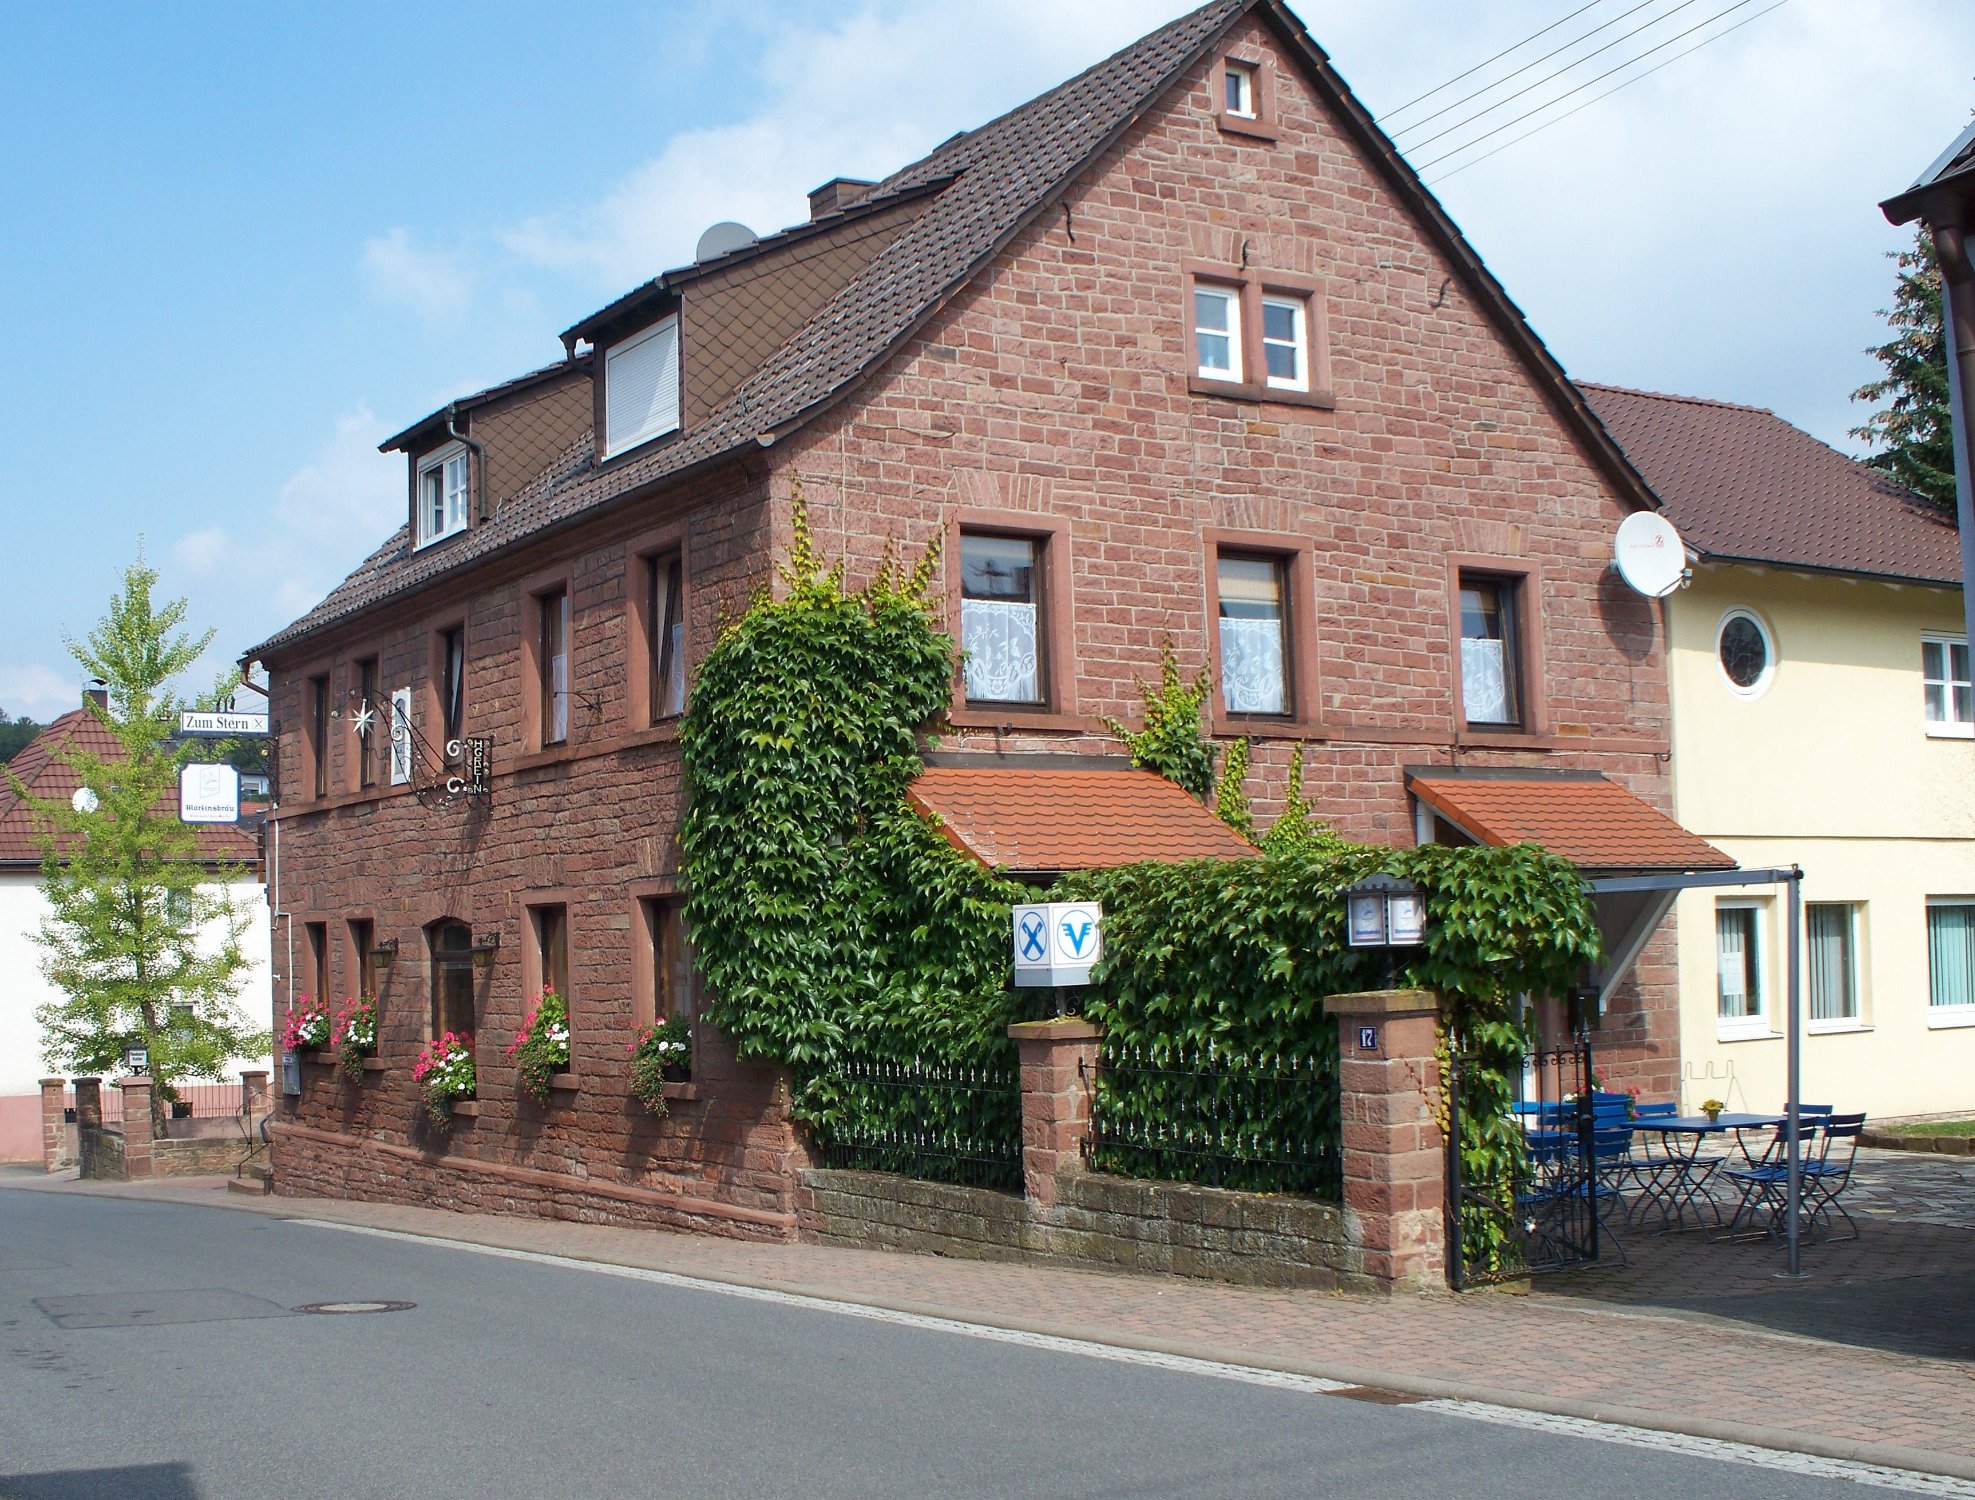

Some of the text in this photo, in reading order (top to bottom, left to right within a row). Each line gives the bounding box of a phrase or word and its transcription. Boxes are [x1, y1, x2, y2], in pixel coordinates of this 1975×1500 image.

[186, 715, 249, 730] Zum Stern
[1361, 1028, 1373, 1047] 17
